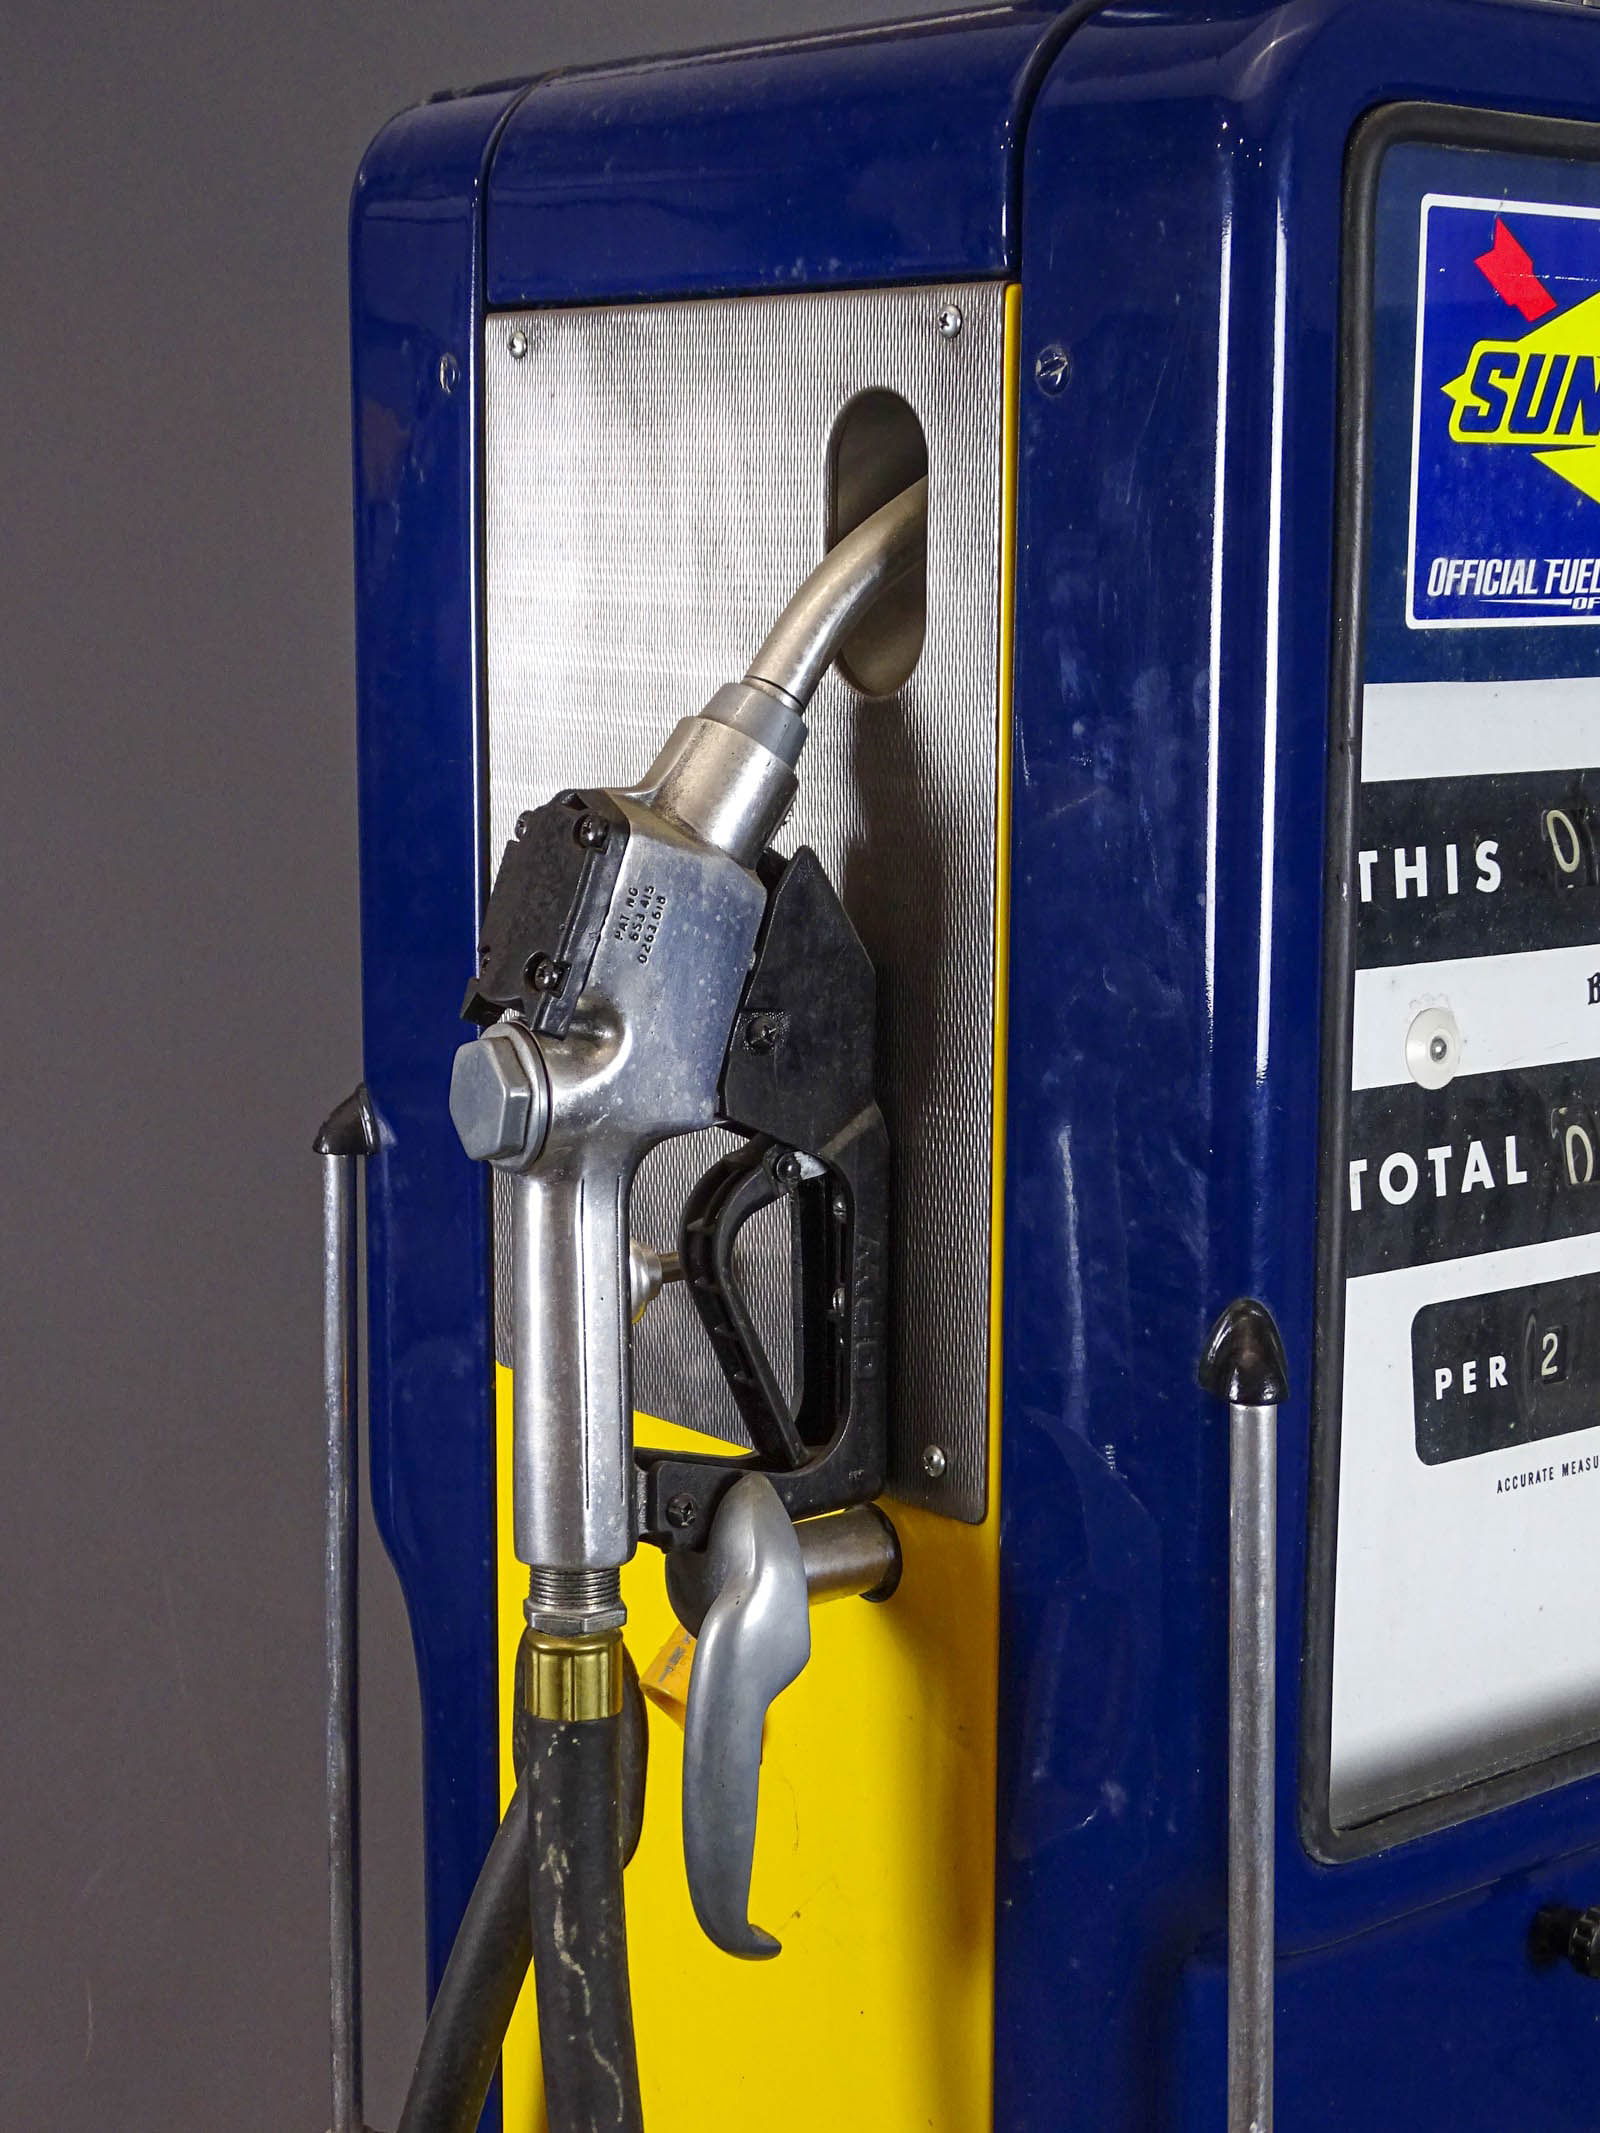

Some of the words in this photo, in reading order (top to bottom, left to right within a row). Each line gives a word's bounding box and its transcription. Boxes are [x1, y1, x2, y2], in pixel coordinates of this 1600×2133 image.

[1427, 557, 1538, 597] OFFICIAL
[1358, 840, 1502, 902] THIS
[613, 913, 630, 941] PAT
[1349, 1135, 1528, 1211] TOTAL
[1435, 1355, 1508, 1400] PER
[1541, 1333, 1558, 1376] 2
[1496, 1466, 1554, 1494] ACCURATE
[1561, 1455, 1599, 1477] MEASU
